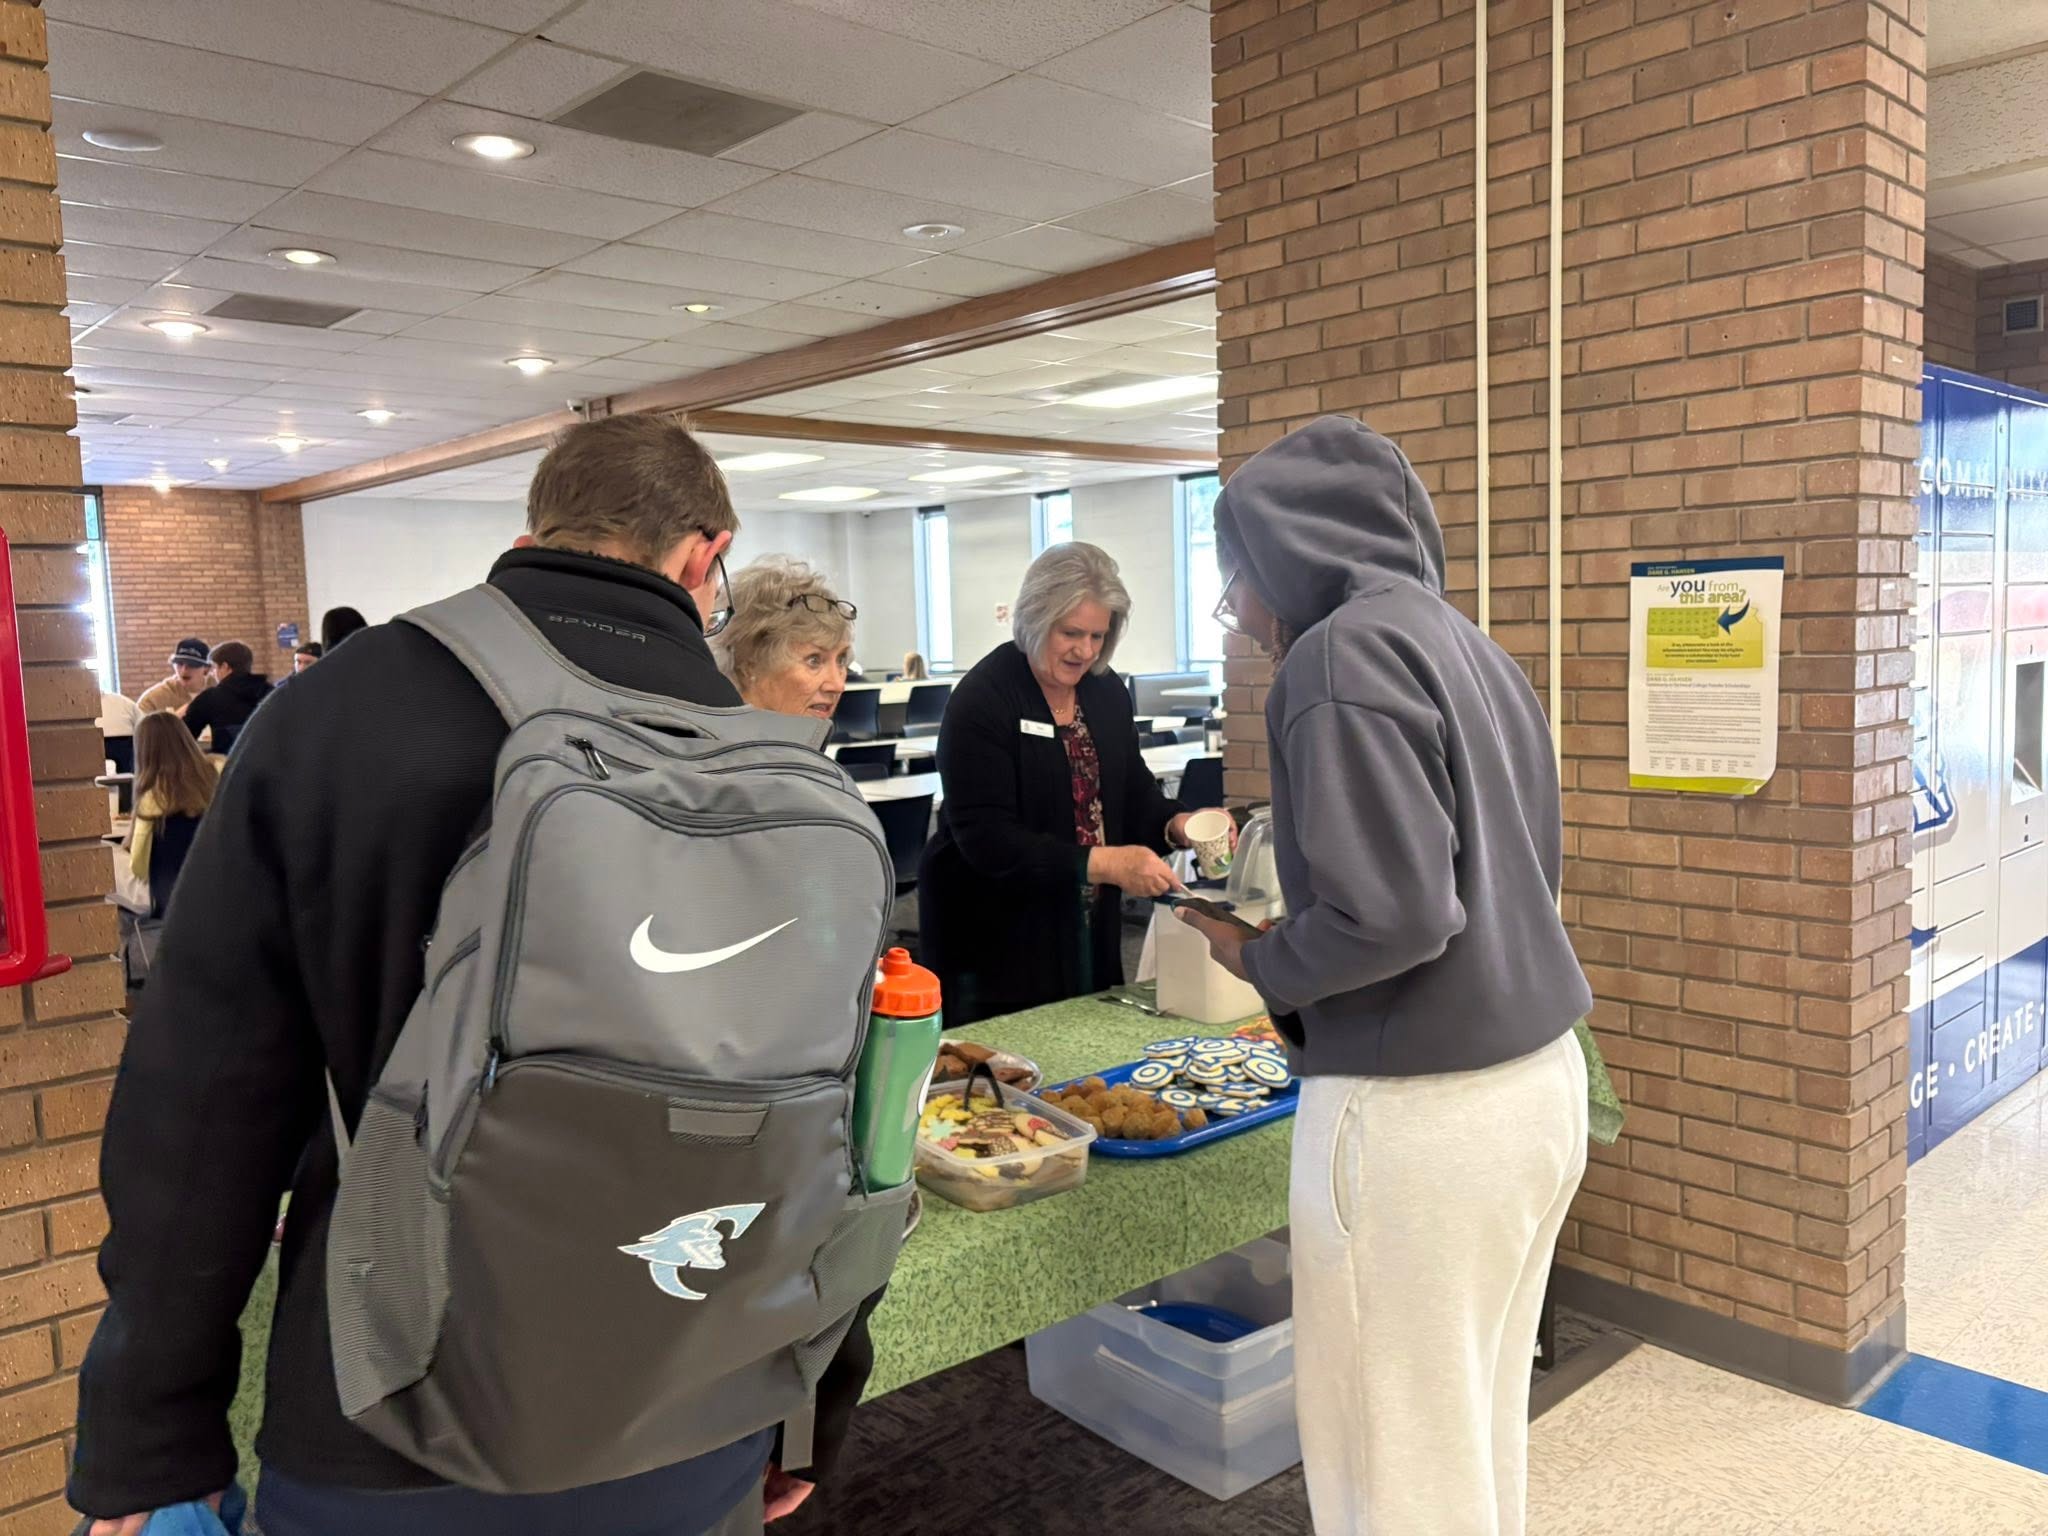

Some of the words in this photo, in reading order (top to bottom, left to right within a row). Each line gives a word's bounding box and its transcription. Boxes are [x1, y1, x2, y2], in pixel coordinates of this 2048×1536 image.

[1919, 456, 2047, 502] COMMNITY
[1657, 584, 1670, 593] Are
[1670, 580, 1705, 598] you
[1708, 580, 1739, 592] from
[1679, 591, 1705, 604] this
[1708, 588, 1747, 604] area?
[548, 615, 646, 643] SPYDER
[1964, 1001, 2034, 1073] CREATE
